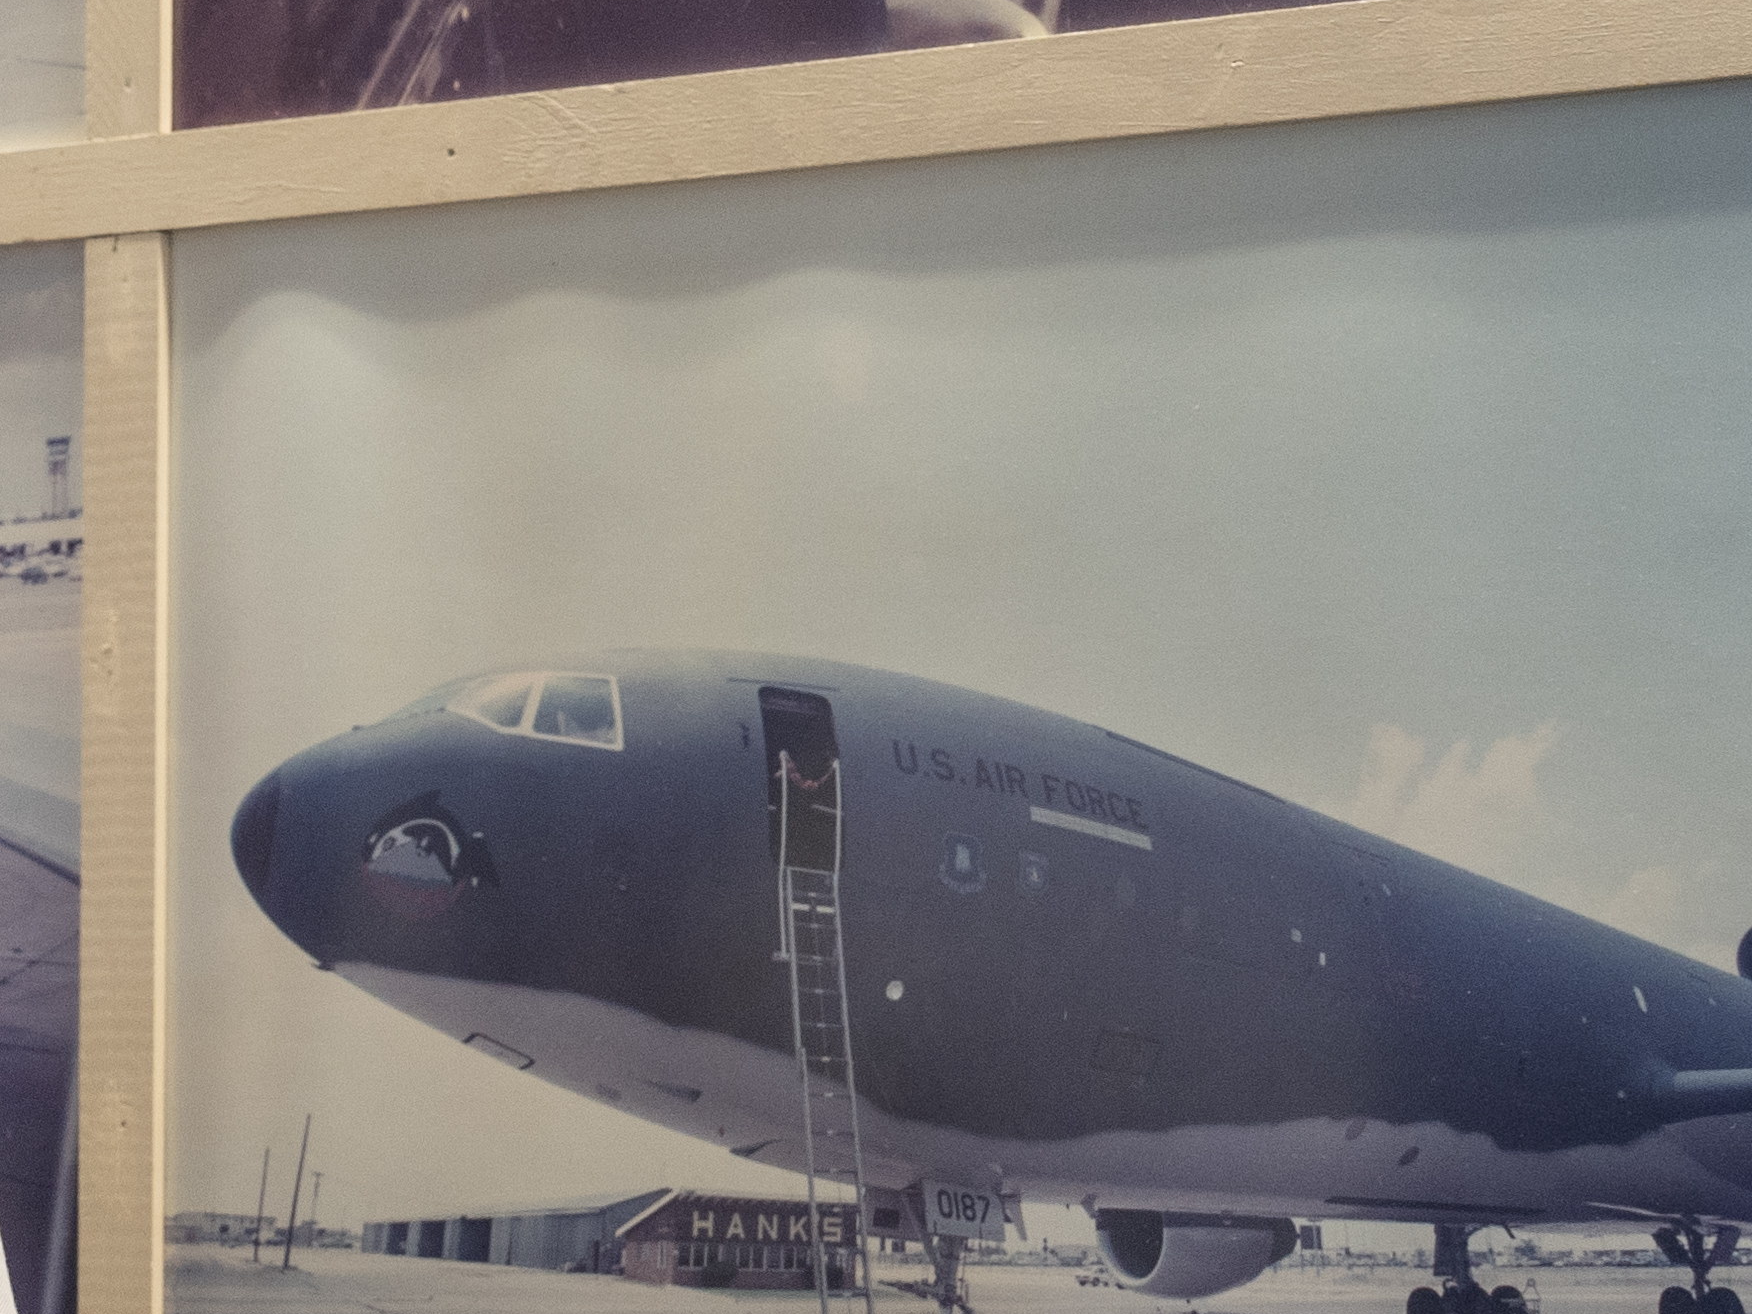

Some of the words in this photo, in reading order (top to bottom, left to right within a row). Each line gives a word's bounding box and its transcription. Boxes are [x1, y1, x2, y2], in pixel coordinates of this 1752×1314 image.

[893, 738, 968, 786] U.S.
[976, 758, 1029, 799] AIR
[1042, 772, 1147, 830] FORCE
[938, 1189, 991, 1223] 0187
